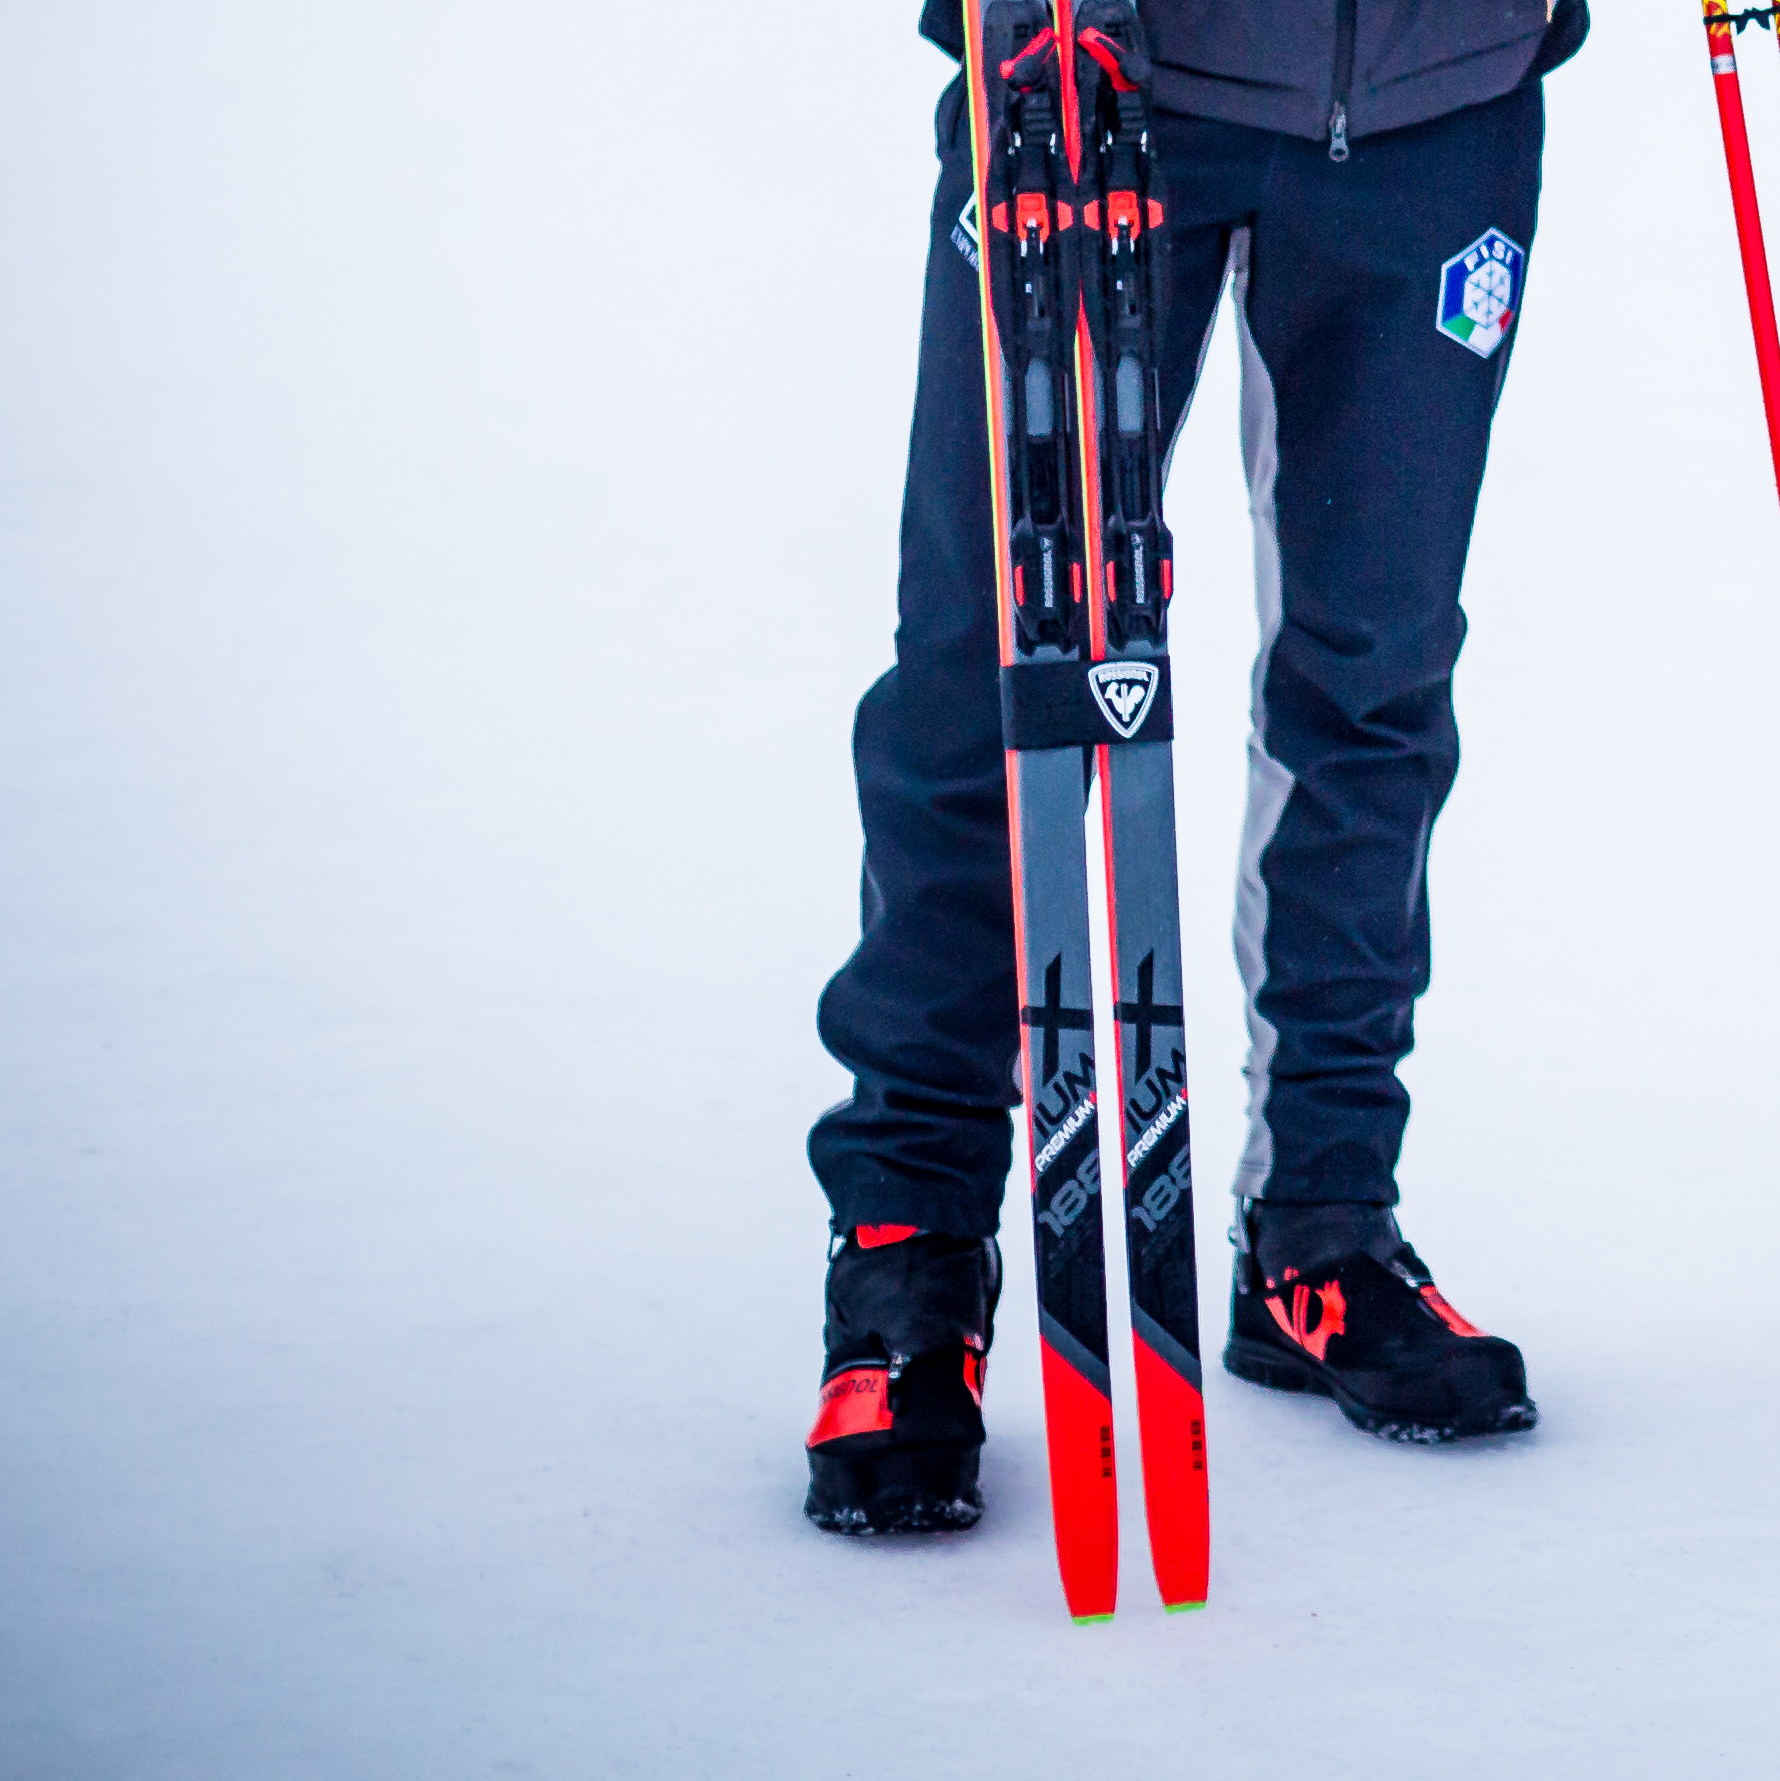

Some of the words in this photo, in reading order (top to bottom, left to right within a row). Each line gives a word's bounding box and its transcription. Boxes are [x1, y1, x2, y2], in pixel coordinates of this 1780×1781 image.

[1461, 237, 1516, 270] FISI
[1034, 1096, 1095, 1172] PREMIUM
[1127, 1093, 1187, 1170] PREMIUM
